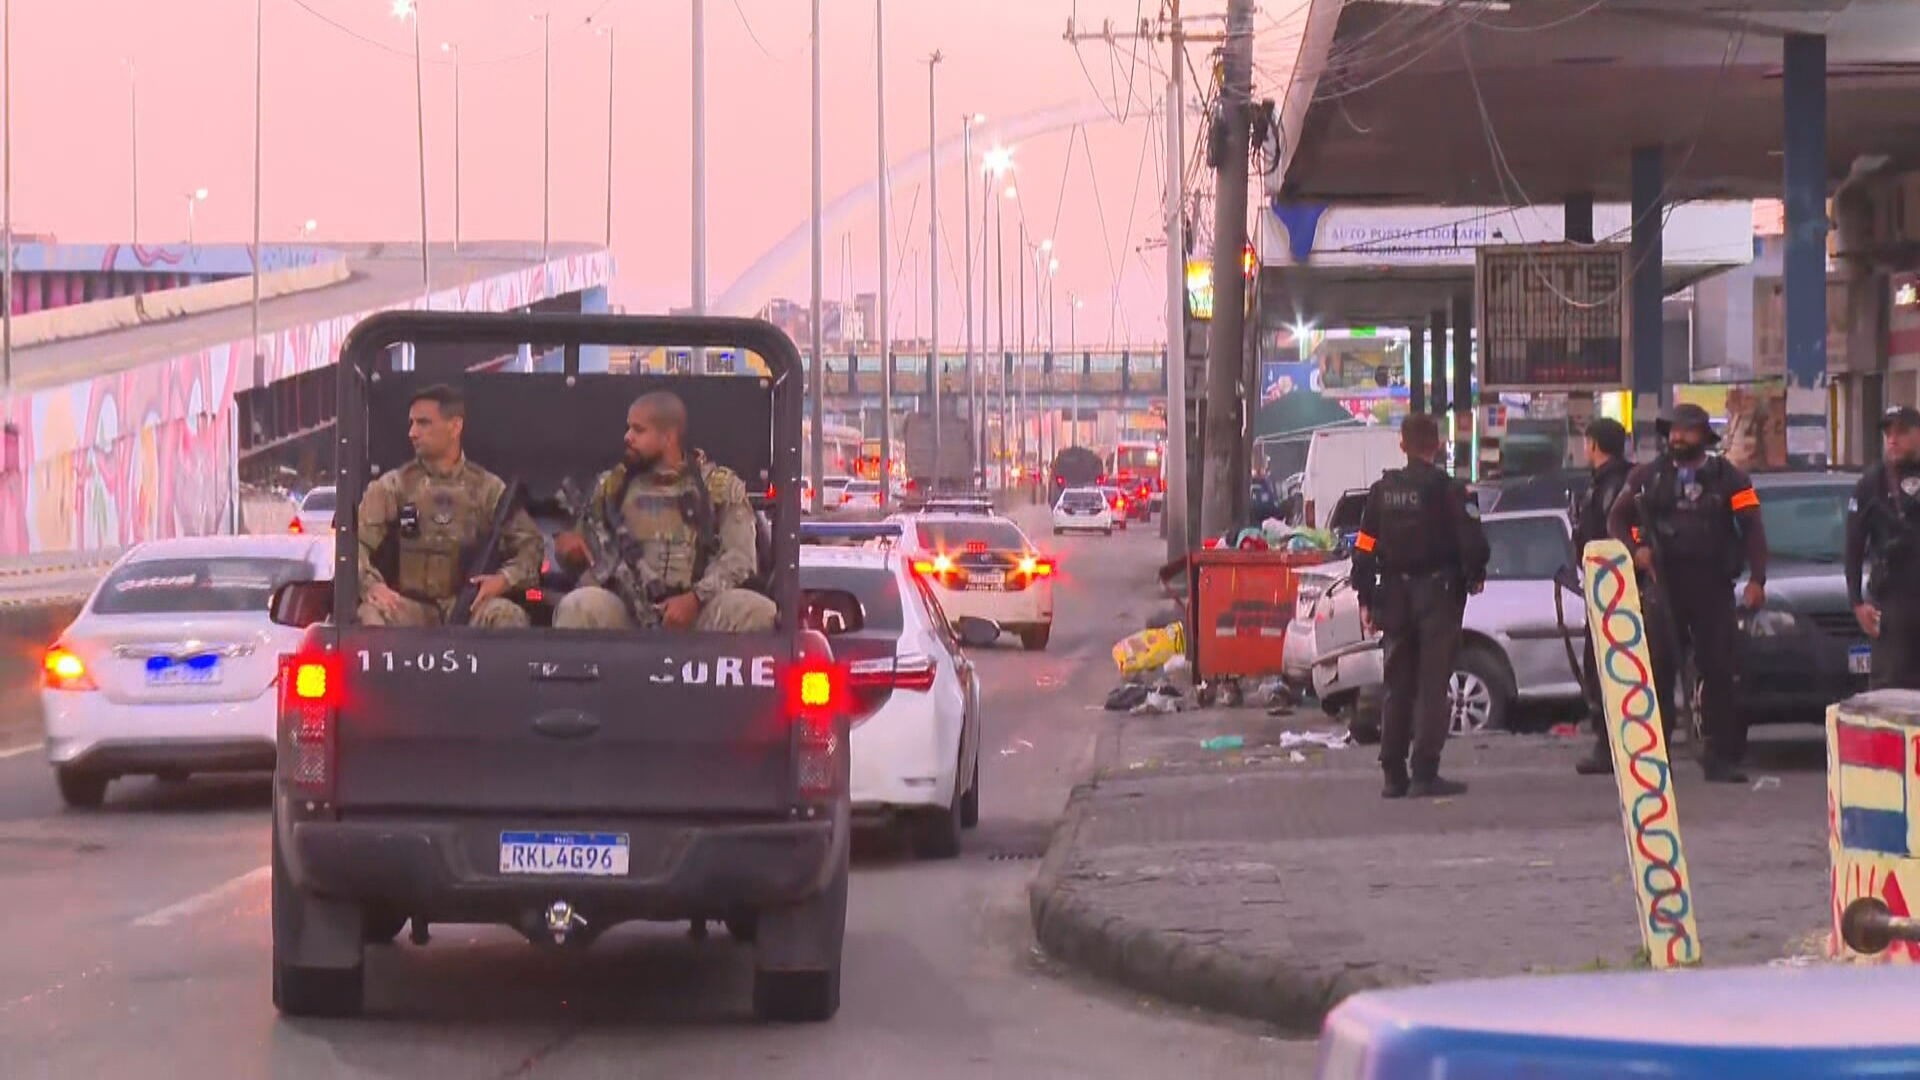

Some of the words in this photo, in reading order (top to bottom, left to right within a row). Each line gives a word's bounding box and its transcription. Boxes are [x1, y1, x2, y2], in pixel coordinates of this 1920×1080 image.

[1331, 228, 1366, 240] AUTO
[357, 649, 479, 674] 11-051
[512, 844, 613, 870] RKL4G96
